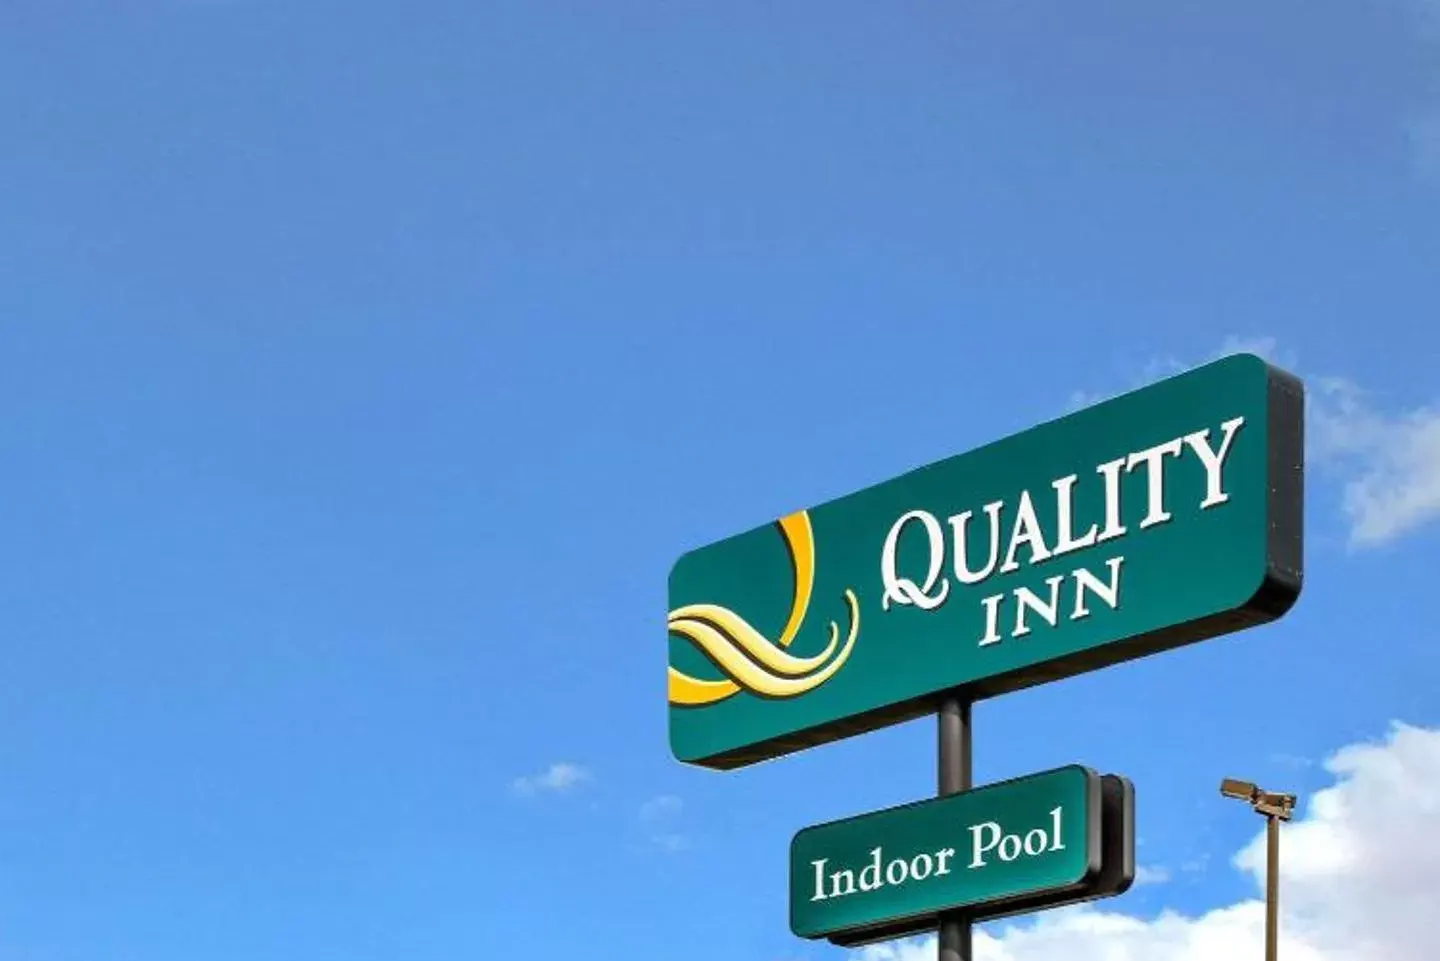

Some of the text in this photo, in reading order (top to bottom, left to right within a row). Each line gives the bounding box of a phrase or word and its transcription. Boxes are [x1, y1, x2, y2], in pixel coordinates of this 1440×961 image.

[882, 416, 1245, 611] QUALITY
[978, 556, 1125, 647] INN
[810, 806, 1066, 901] Indoor Pool
